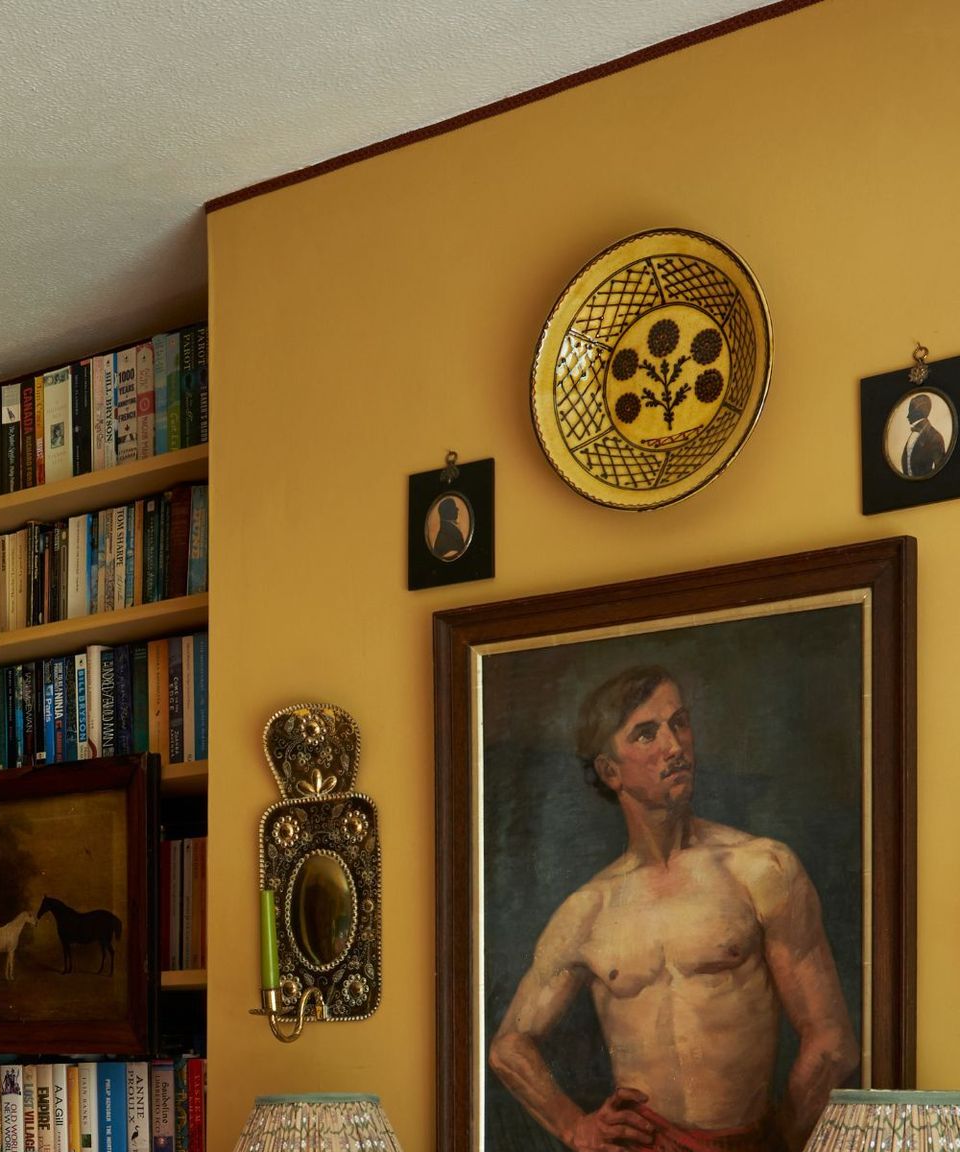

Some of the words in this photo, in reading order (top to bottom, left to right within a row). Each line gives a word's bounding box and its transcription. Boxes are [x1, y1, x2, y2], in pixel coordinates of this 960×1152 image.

[183, 334, 191, 371] PAROT
[105, 371, 113, 395] BILL
[118, 368, 135, 384] 1000
[118, 384, 135, 395] YEARS
[23, 387, 33, 435] CANADA
[105, 398, 113, 442] BRYSON
[116, 510, 125, 531] TOM
[116, 532, 125, 567] SHARPE
[78, 670, 86, 694] BILL
[45, 698, 53, 723] Paris
[78, 695, 86, 741] BRYSON
[24, 1083, 35, 1109] LOST
[37, 1087, 51, 1131] EMPIRE
[136, 1075, 144, 1119] ANNIE
[161, 1082, 170, 1124] Baudolino
[25, 1110, 36, 1152] VILLAGE
